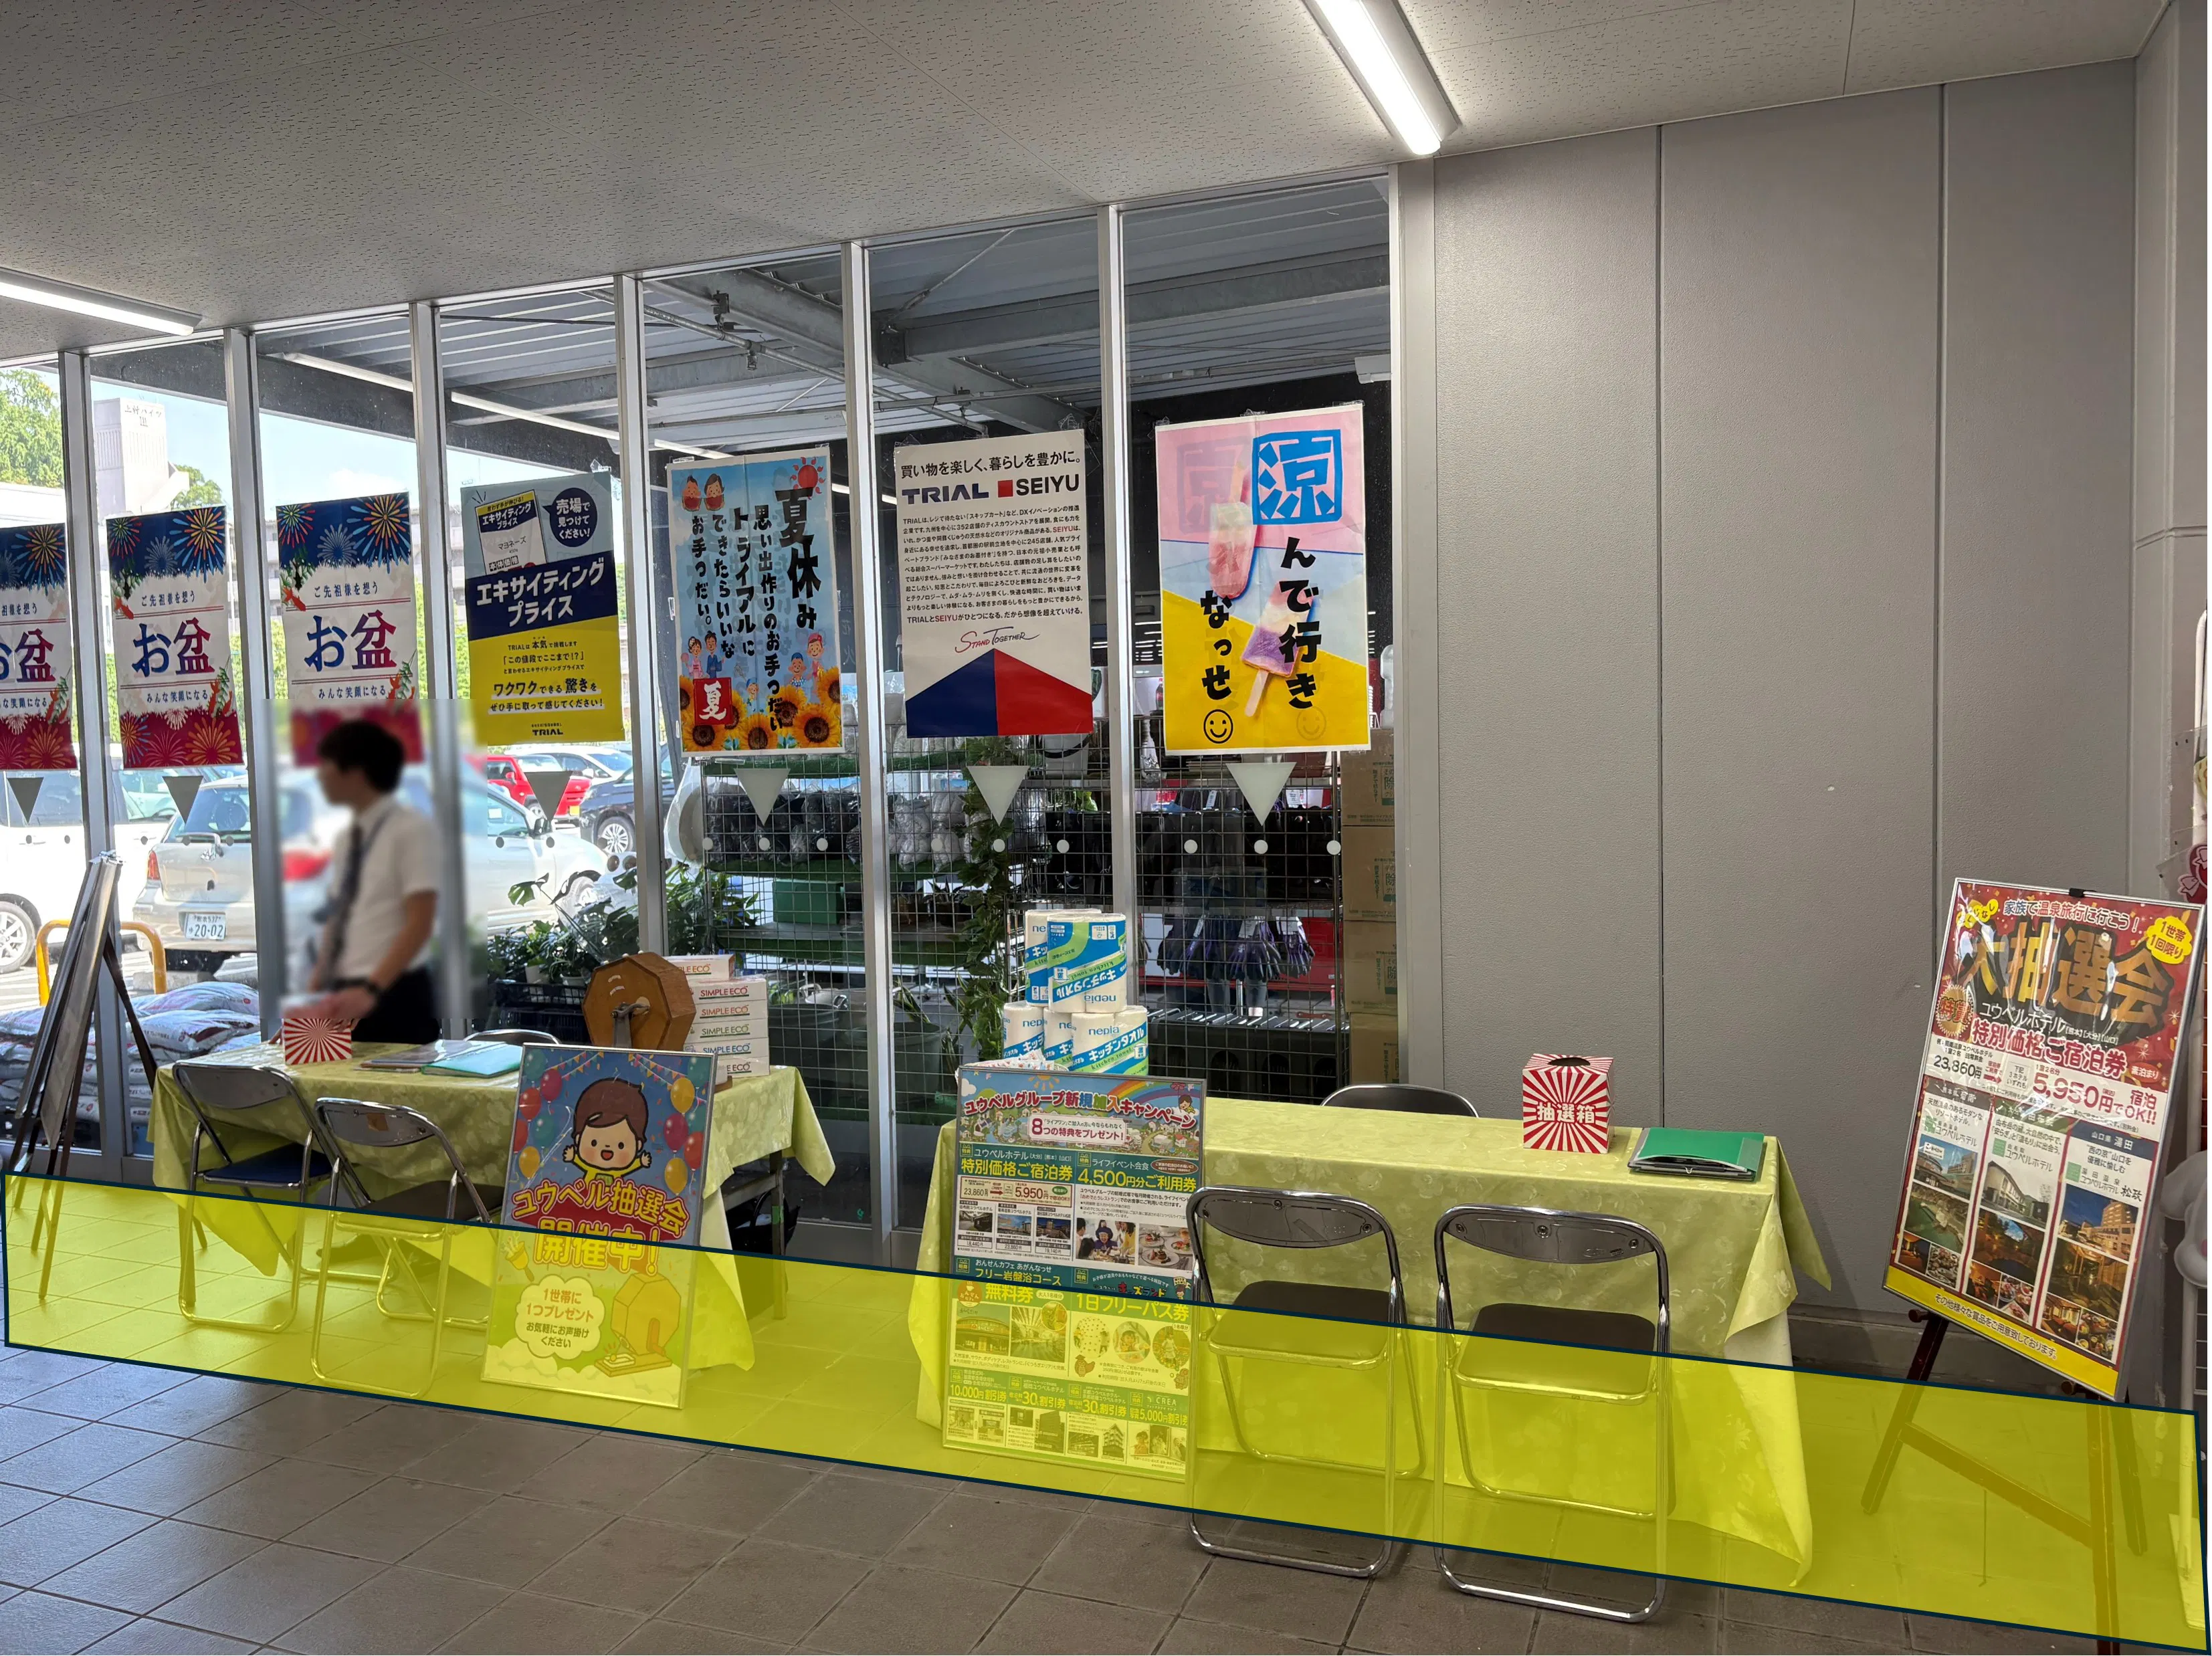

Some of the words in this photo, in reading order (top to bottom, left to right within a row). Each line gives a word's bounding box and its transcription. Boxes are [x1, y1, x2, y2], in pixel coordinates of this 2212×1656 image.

[901, 450, 1080, 479] 買い物を楽しく、暮らしを豊かに。
[902, 483, 989, 504] TRIAL
[1016, 474, 1080, 496] SEIYU
[1255, 433, 1338, 523] 涼
[482, 501, 532, 526] エキサイティング
[556, 498, 591, 515] 売場で
[558, 514, 590, 528] 見つけて
[498, 536, 526, 550] マヨネーズ
[559, 528, 591, 540] ください!
[774, 486, 823, 631] 夏休み
[690, 514, 712, 626] お手つだい。
[314, 581, 379, 598] ご先祖様を想う
[476, 557, 605, 606] エキサイティング
[712, 513, 736, 659] できたらいいな
[732, 506, 756, 657] トライアルに
[141, 592, 196, 607] ご先祖様を想う
[508, 595, 573, 627] プライス
[752, 504, 783, 732] 思い出作りのお手つだい
[1278, 536, 1322, 710] んで行き
[132, 617, 215, 678] お盆
[304, 609, 397, 672] お盆
[1201, 590, 1233, 701] なっせ
[146, 690, 209, 703] みんな笑顔になる
[318, 686, 387, 700] みんな笑顔になる
[493, 678, 597, 697] ワクワクできる驚きを
[0, 698, 47, 709] な笑顔になる
[490, 698, 603, 712] ぜひ手に取って感じてください!
[699, 680, 727, 720] 夏
[2003, 899, 2140, 933] 家族で温泉旅行に行こう!
[2160, 921, 2186, 942] 1世帯
[2149, 934, 2183, 959] 1回限り
[1056, 969, 1117, 999] キッチンタオル
[1957, 921, 2173, 1027] 大抽選会
[700, 989, 728, 997] SIMPLE
[730, 987, 748, 995] ECO
[1084, 995, 1116, 1003] nepia
[702, 1007, 730, 1016] SIMPLE
[730, 1005, 748, 1013] ECO
[1979, 1003, 2066, 1033] ユウベルホテル
[702, 1027, 730, 1035] SIMPLE
[730, 1025, 748, 1033] ECO
[1088, 1025, 1119, 1036] nepia
[703, 1046, 730, 1054] SIMPLE
[732, 1045, 750, 1053] ECO
[1088, 1027, 1144, 1062] キッチンタオル
[1972, 1017, 2128, 1079] 特別価格ご宿泊券
[732, 1063, 750, 1071] ECO
[1091, 1057, 1115, 1070] kitchen
[1933, 1055, 1982, 1079] 23,860円
[964, 1090, 1197, 1130] ユウベルグループ新規加入キャンペーン
[2130, 1090, 2158, 1110] 宿泊
[1536, 1102, 1597, 1124] 抽選箱
[1031, 1118, 1124, 1141] 8つの特典をプレゼント!
[1936, 1126, 1977, 1147] ユウベルホテル
[974, 1149, 1029, 1160] ユウベルホテル
[1092, 1158, 1149, 1170] ライフイベント会食
[2005, 1149, 2053, 1172] ユウベルホテル
[961, 1158, 1072, 1181] 特別価格ご宿泊券
[1078, 1168, 1197, 1193] 4,500円分ご利用券
[2080, 1175, 2119, 1195] ユウベルホテル
[512, 1178, 688, 1236] ユウベル抽選会
[533, 1217, 661, 1276] 開催中!
[975, 1259, 1015, 1270] おんせんカフェ
[1016, 1263, 1052, 1273] あがんなっせ
[975, 1268, 1062, 1286] フリー岩盤浴コース
[543, 1288, 582, 1305] 1世帯に
[985, 1282, 1033, 1304] 無料券
[526, 1304, 594, 1324] 1つプレゼント
[1076, 1293, 1189, 1322] 1日フリーパス券
[526, 1322, 590, 1339] お気軽にお声掛け
[1934, 1293, 2058, 1361] その他様々な賞品をご用意致しております。
[540, 1337, 571, 1348] ください
[1156, 1396, 1177, 1407] CREA
